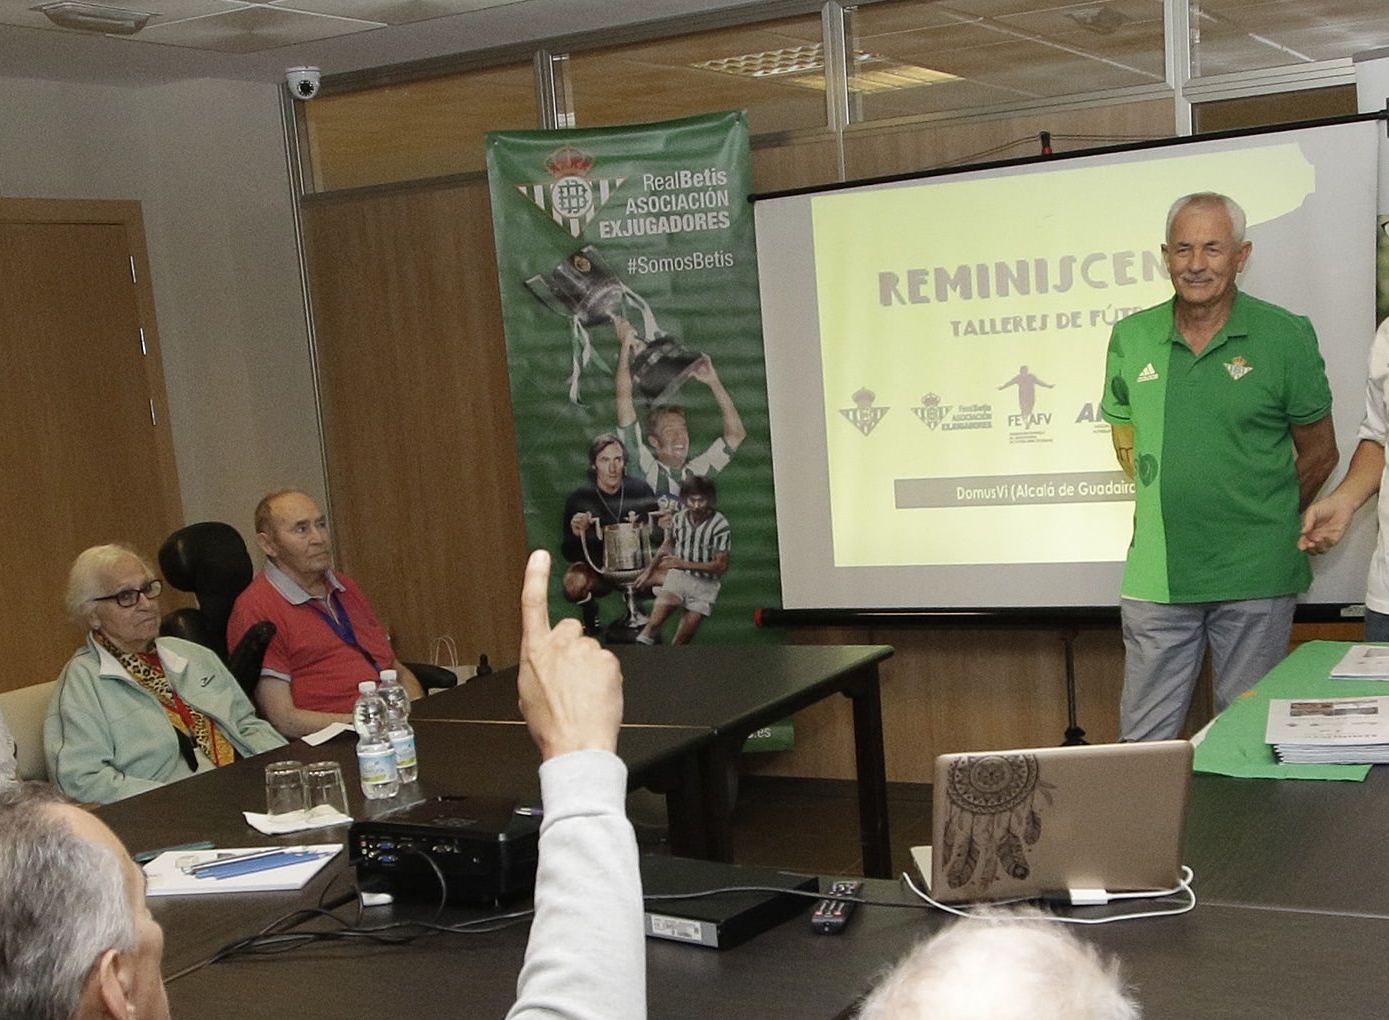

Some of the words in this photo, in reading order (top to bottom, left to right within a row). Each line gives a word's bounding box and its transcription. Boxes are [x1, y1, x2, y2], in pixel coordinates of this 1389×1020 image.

[626, 187, 730, 215] ASOCIACIÓN
[599, 211, 731, 238] EXJUGADORES
[627, 250, 734, 275] #SomosBetis
[950, 313, 1049, 337] TALLERES
[1056, 311, 1082, 329] DE
[956, 484, 1008, 500] DomusVi
[1011, 481, 1055, 501] (Alcalá
[1059, 483, 1075, 496] de
